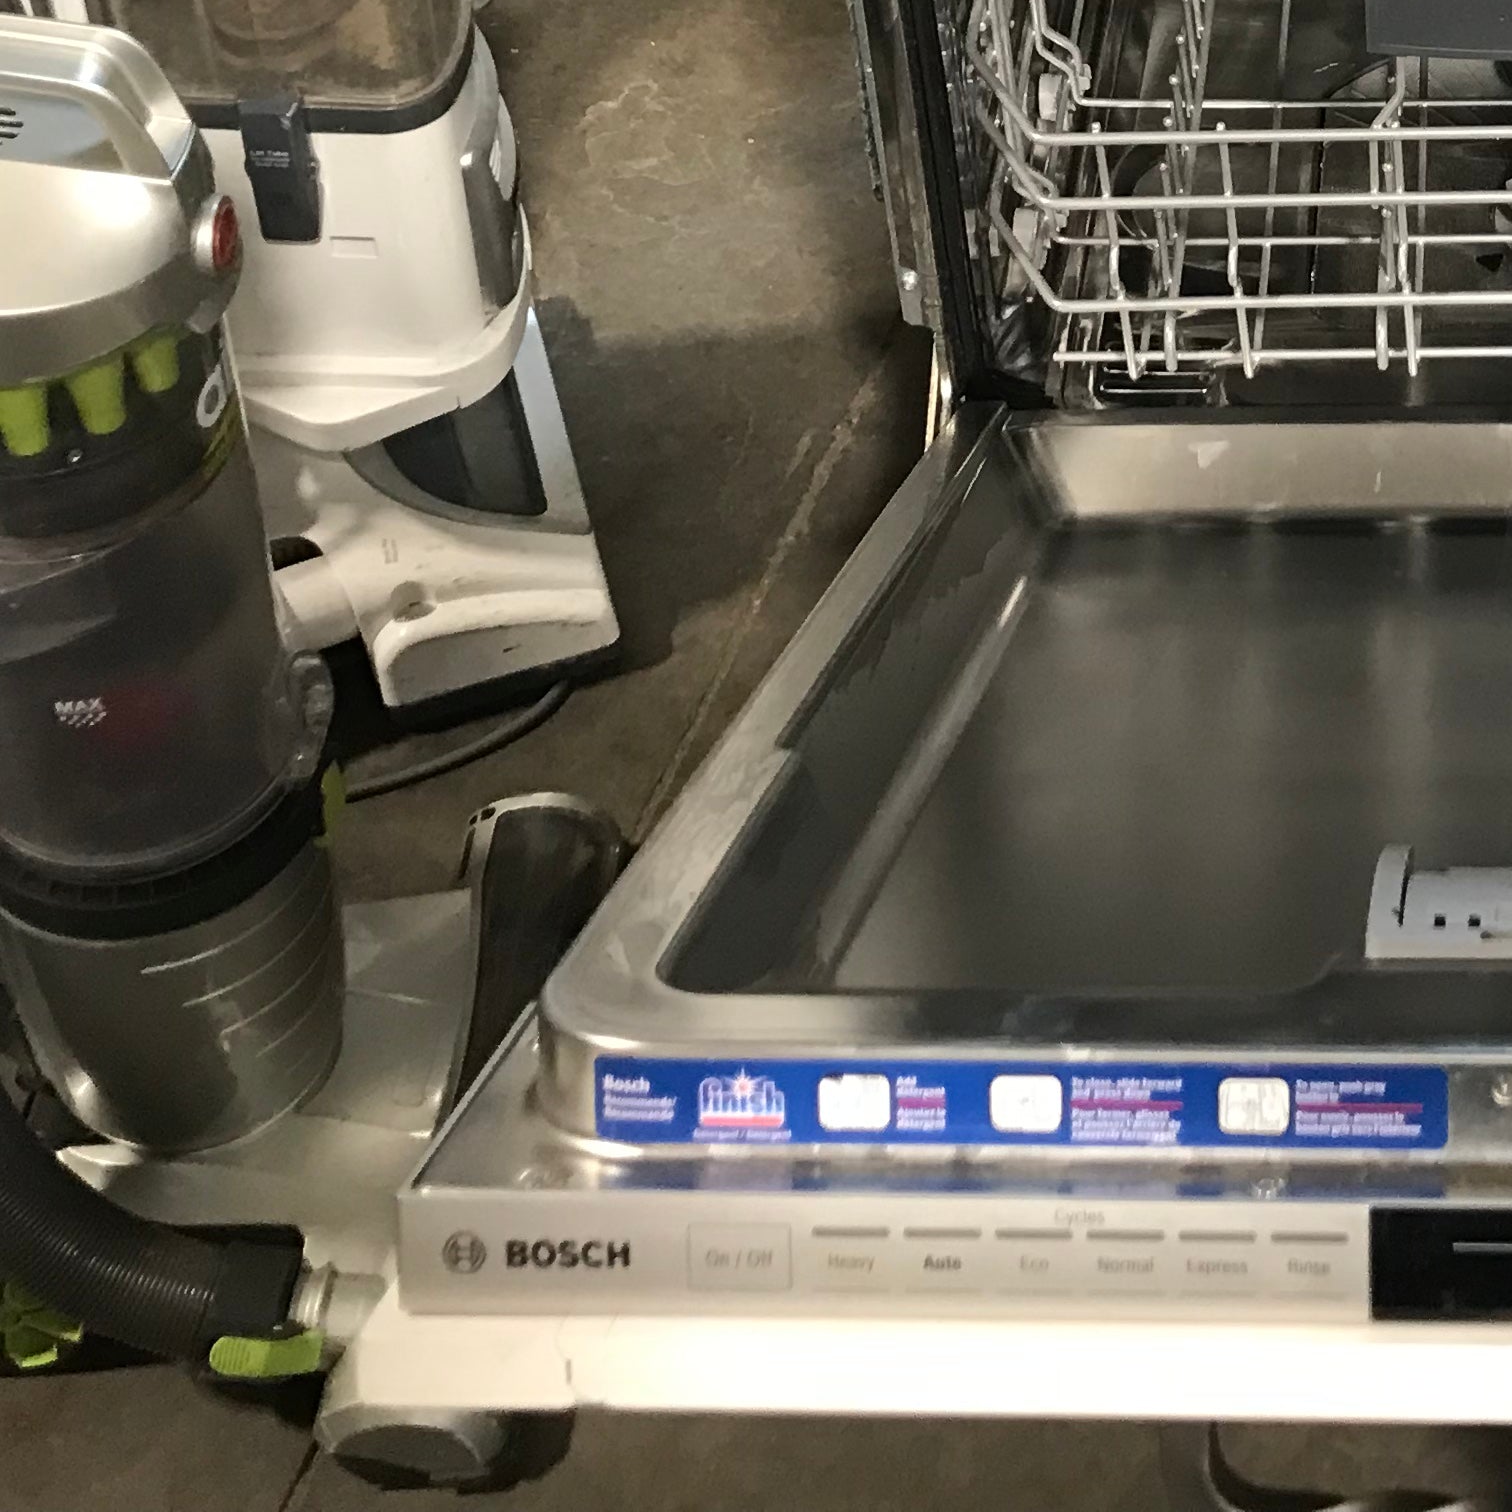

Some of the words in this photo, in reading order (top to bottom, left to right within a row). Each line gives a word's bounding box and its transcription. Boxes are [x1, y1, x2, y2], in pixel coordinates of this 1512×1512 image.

[55, 698, 105, 713] MAX
[603, 1074, 650, 1094] Bosch
[896, 1076, 917, 1086] Add
[1054, 1208, 1105, 1228] Cycles
[505, 1239, 631, 1269] BOSCH
[705, 1249, 730, 1269] On
[746, 1248, 773, 1268] Off
[923, 1254, 962, 1272] Auto
[1020, 1255, 1049, 1271] Eco
[827, 1253, 875, 1274] Heavy
[1097, 1256, 1155, 1274] Normal
[1186, 1257, 1248, 1276] Express
[1287, 1258, 1331, 1276] Rinse
